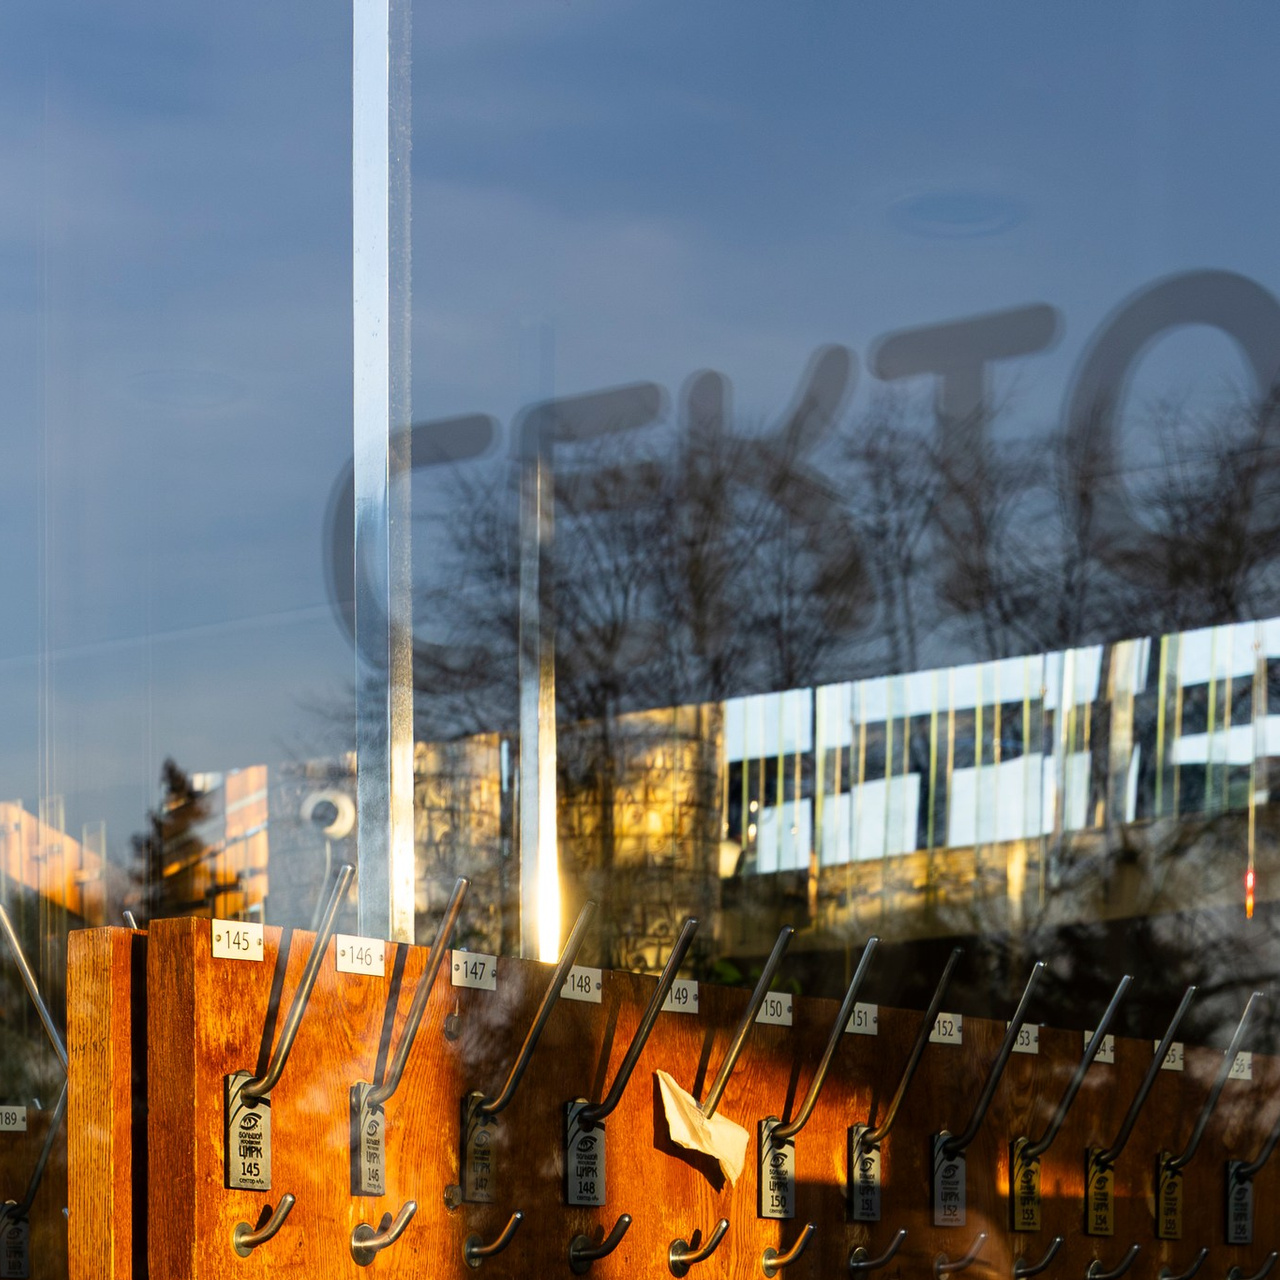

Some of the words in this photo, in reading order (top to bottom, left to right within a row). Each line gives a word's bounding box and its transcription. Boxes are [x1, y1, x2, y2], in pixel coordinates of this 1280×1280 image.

[225, 930, 249, 951] 145
[349, 945, 372, 966] 146
[463, 960, 486, 981] 147
[570, 973, 591, 993] 148
[670, 986, 688, 1005] 149
[764, 999, 782, 1018] 150
[852, 1010, 868, 1027] 151
[937, 1020, 953, 1037] 152
[0, 1112, 17, 1126] 189
[238, 1146, 263, 1159] ЦИРК
[241, 1162, 260, 1177] 145
[368, 1168, 380, 1181] 146
[578, 1181, 595, 1194] 148
[771, 1195, 786, 1208] 150
[861, 1199, 873, 1211] 151
[943, 1205, 957, 1217] 152
